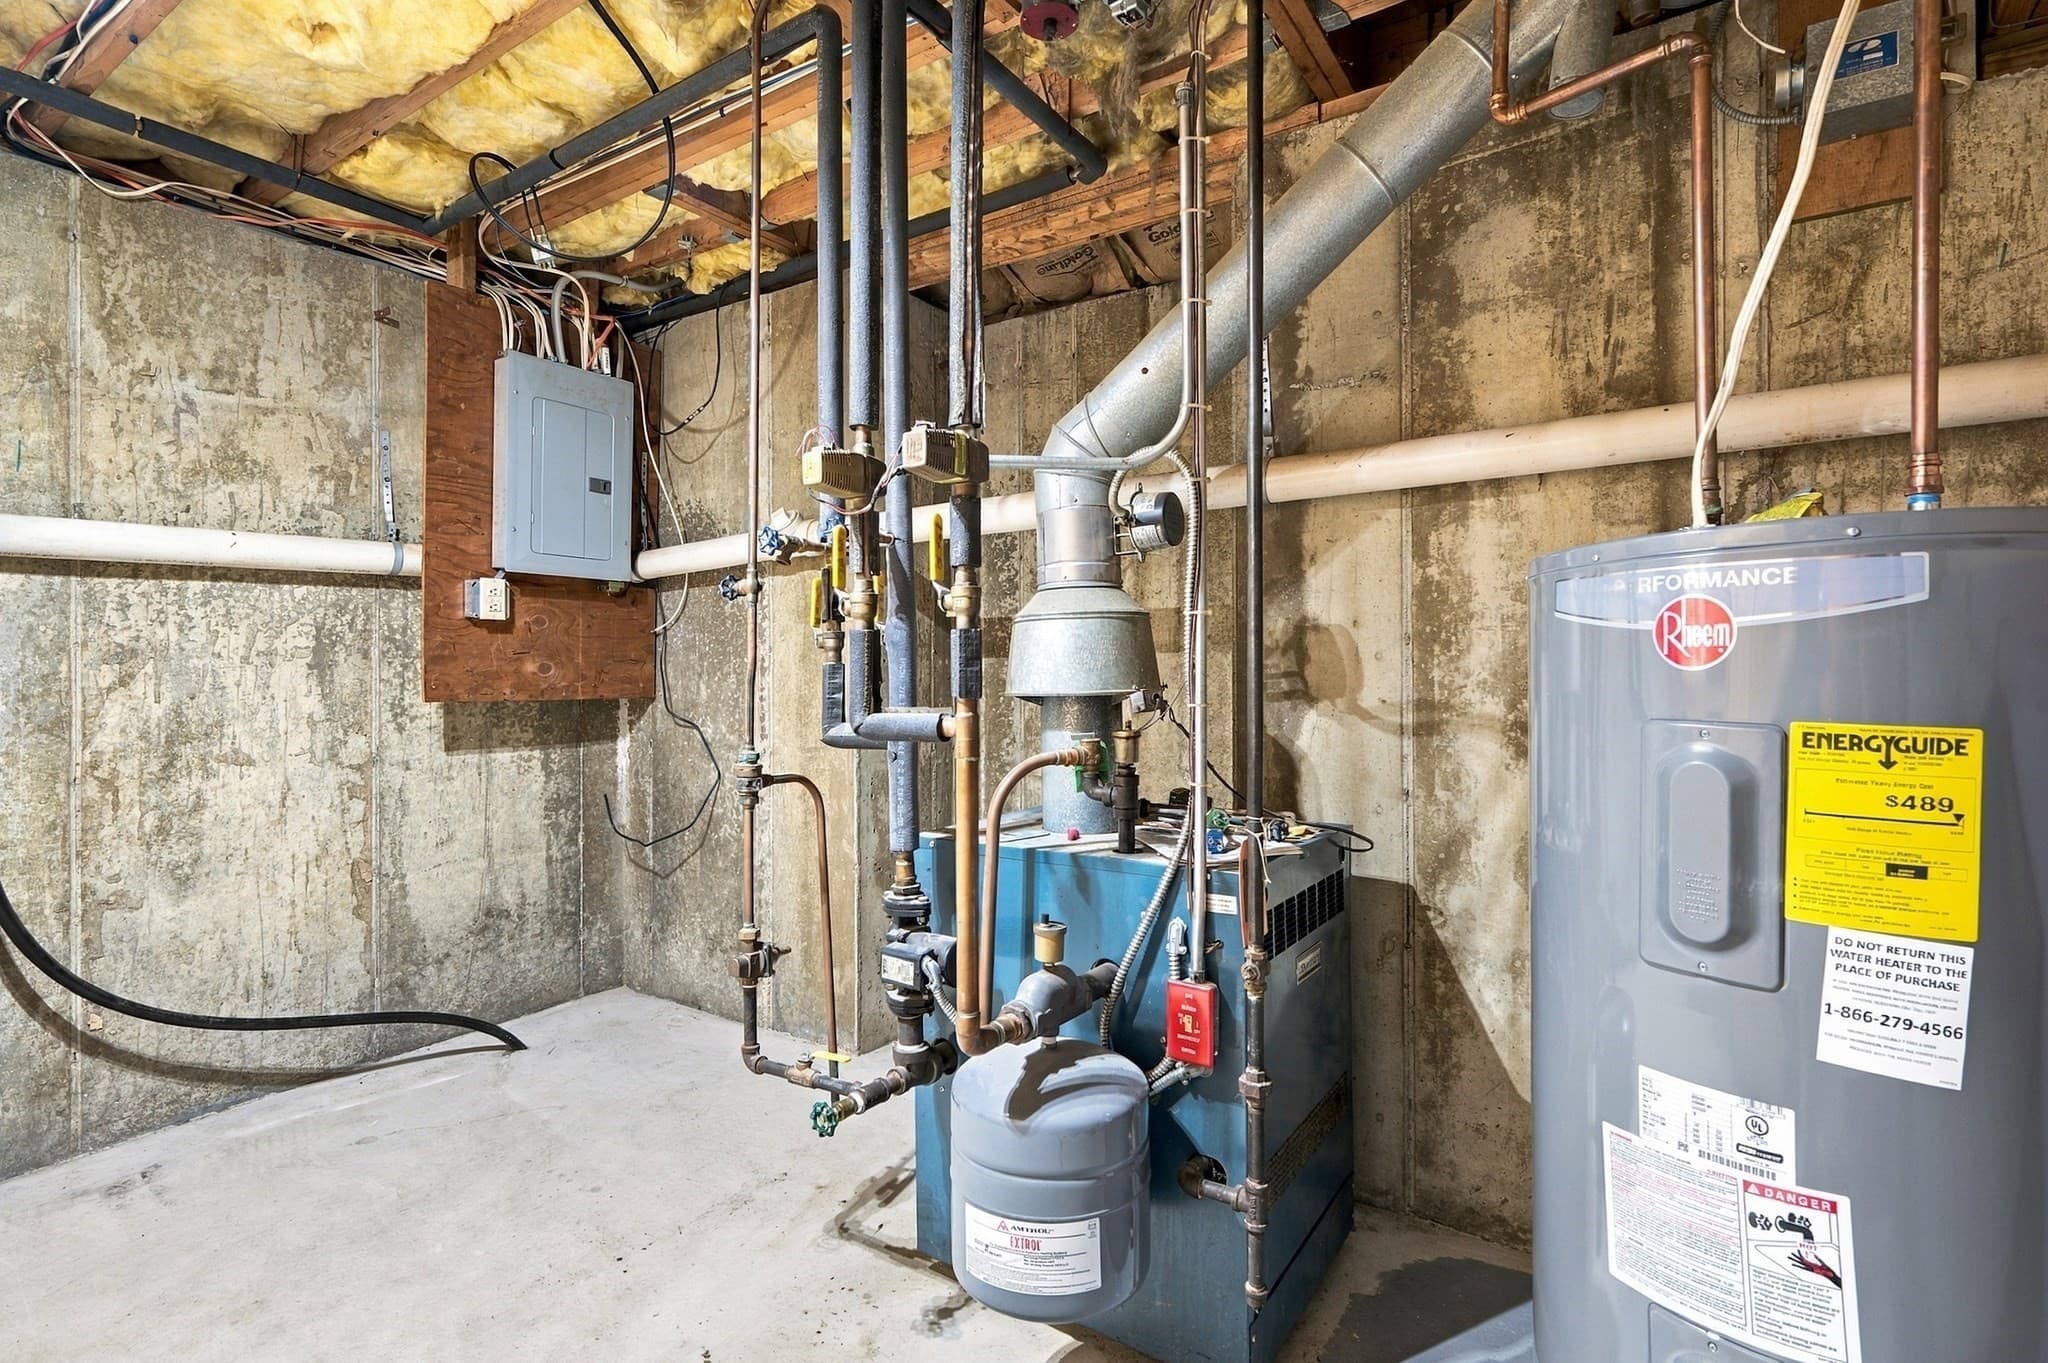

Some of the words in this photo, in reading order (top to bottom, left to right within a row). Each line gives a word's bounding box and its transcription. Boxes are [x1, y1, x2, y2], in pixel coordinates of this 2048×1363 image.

[1148, 222, 1181, 243] Gold
[1637, 566, 1797, 593] RFORMANCE
[1663, 599, 1730, 658] Rheem
[1802, 731, 1969, 757] ENERGYGUIDE
[1830, 948, 1872, 964] WATER
[1875, 956, 1922, 973] HEATER
[1925, 964, 1941, 975] TO
[1944, 967, 1968, 980] THE
[1834, 936, 1853, 948] DO
[1856, 939, 1884, 952] NOT
[1886, 943, 1936, 961] RETURN
[1938, 952, 1967, 966] THIS
[1835, 963, 1872, 977] PLACE
[1875, 970, 1892, 981] OF
[1894, 973, 1961, 992] PURCHASE
[1824, 1002, 1964, 1040] 1-866-279-4566
[1764, 1188, 1831, 1211] DANGER
